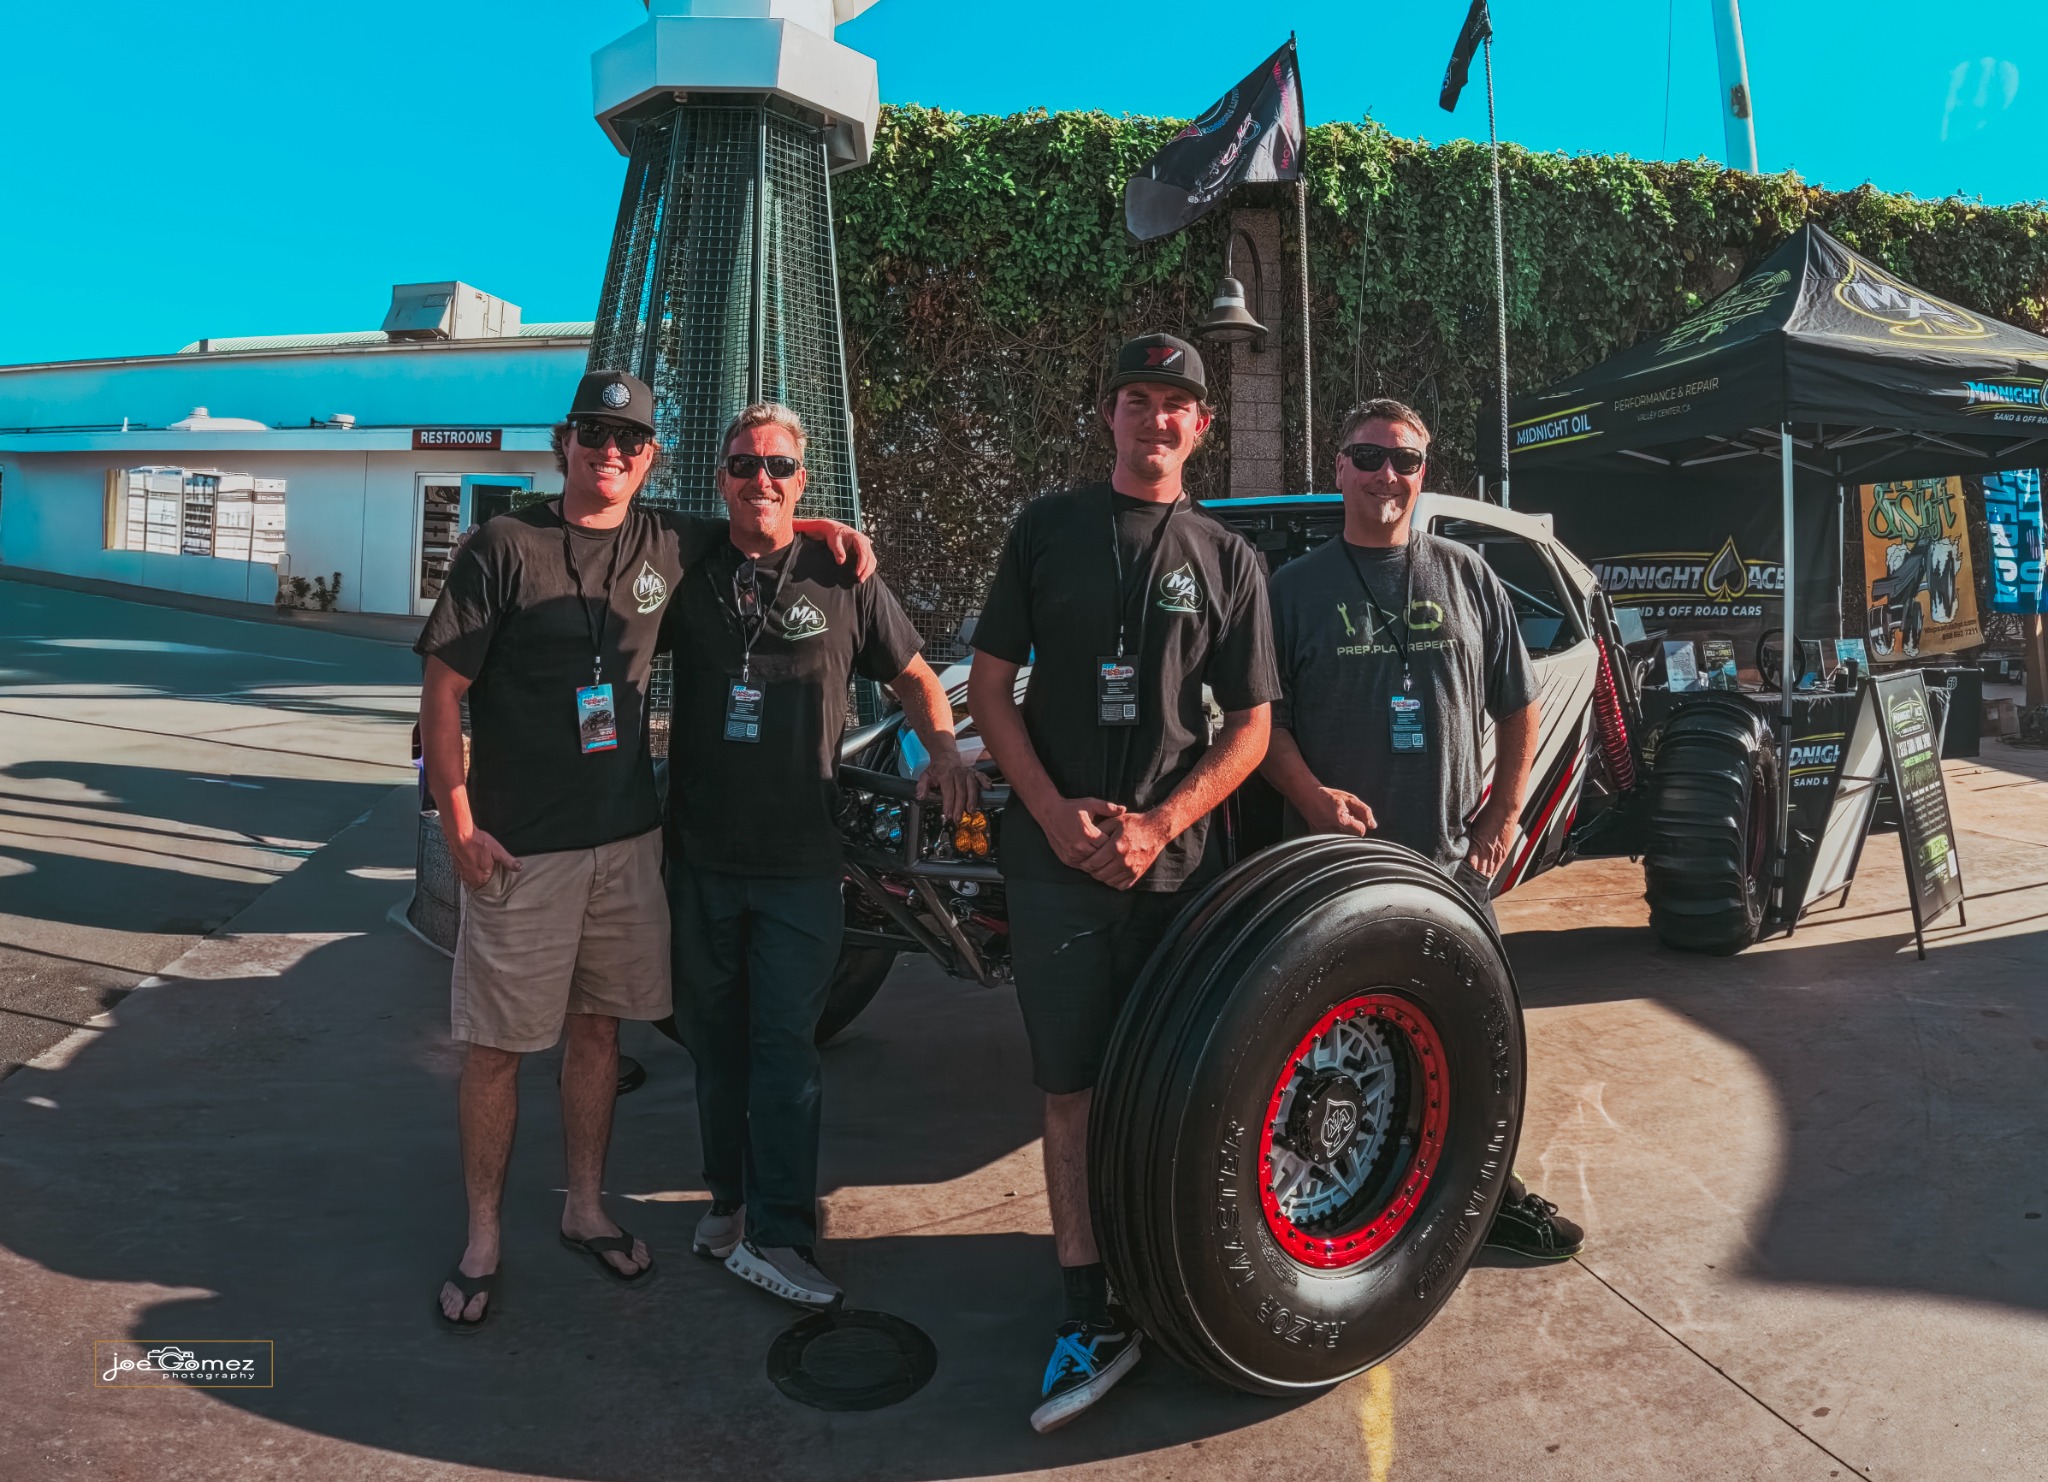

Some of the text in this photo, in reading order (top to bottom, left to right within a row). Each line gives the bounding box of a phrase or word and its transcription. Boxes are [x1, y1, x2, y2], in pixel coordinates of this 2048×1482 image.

[1614, 377, 1719, 411] PERFORMANCE & REPAIR
[1960, 381, 2040, 404] MIDNIGHT
[1636, 409, 1657, 421] VALLEY
[1993, 412, 2014, 421] SAND
[2022, 415, 2037, 423] OFF
[420, 431, 492, 443] RESTROOMS
[1516, 413, 1592, 445] MIDNIGHT OIL
[1656, 607, 1665, 617] &
[1668, 606, 1691, 617] OFF
[1694, 606, 1728, 616] ROAD
[1732, 605, 1762, 616] CARS
[1793, 776, 1829, 787] SAND &
[1217, 1116, 1257, 1288] MASTER
[1256, 1295, 1347, 1348] RAZOR
